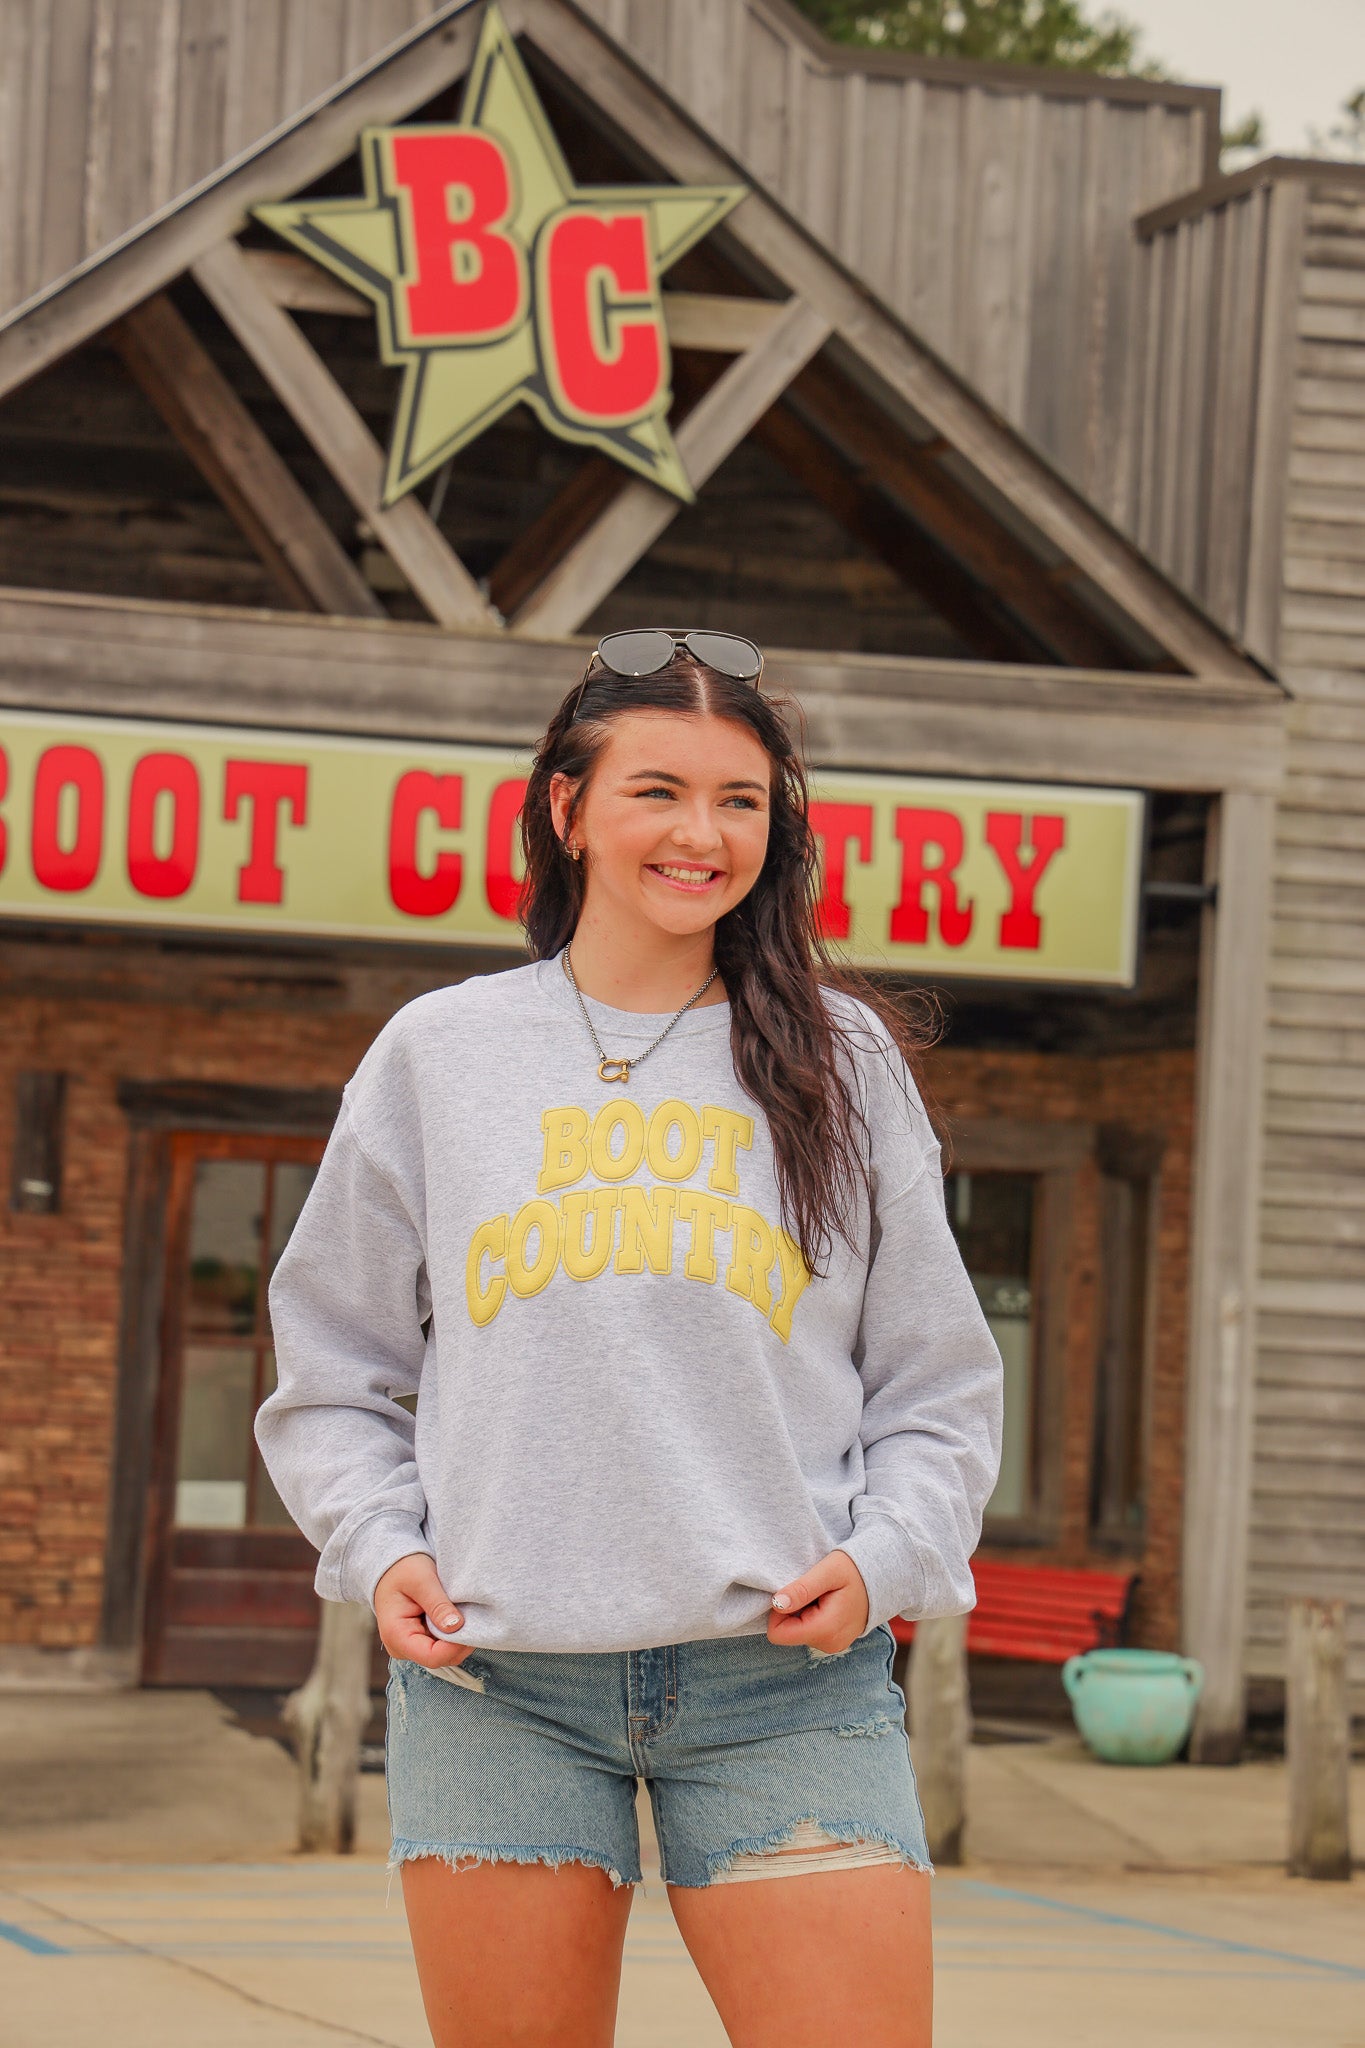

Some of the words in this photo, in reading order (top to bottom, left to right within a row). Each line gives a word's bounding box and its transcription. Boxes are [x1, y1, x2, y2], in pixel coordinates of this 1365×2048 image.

[0, 744, 308, 905] OOT
[389, 769, 1065, 951] COTRY
[537, 1099, 754, 1196] BOOT
[466, 1185, 813, 1344] COUNTRY
